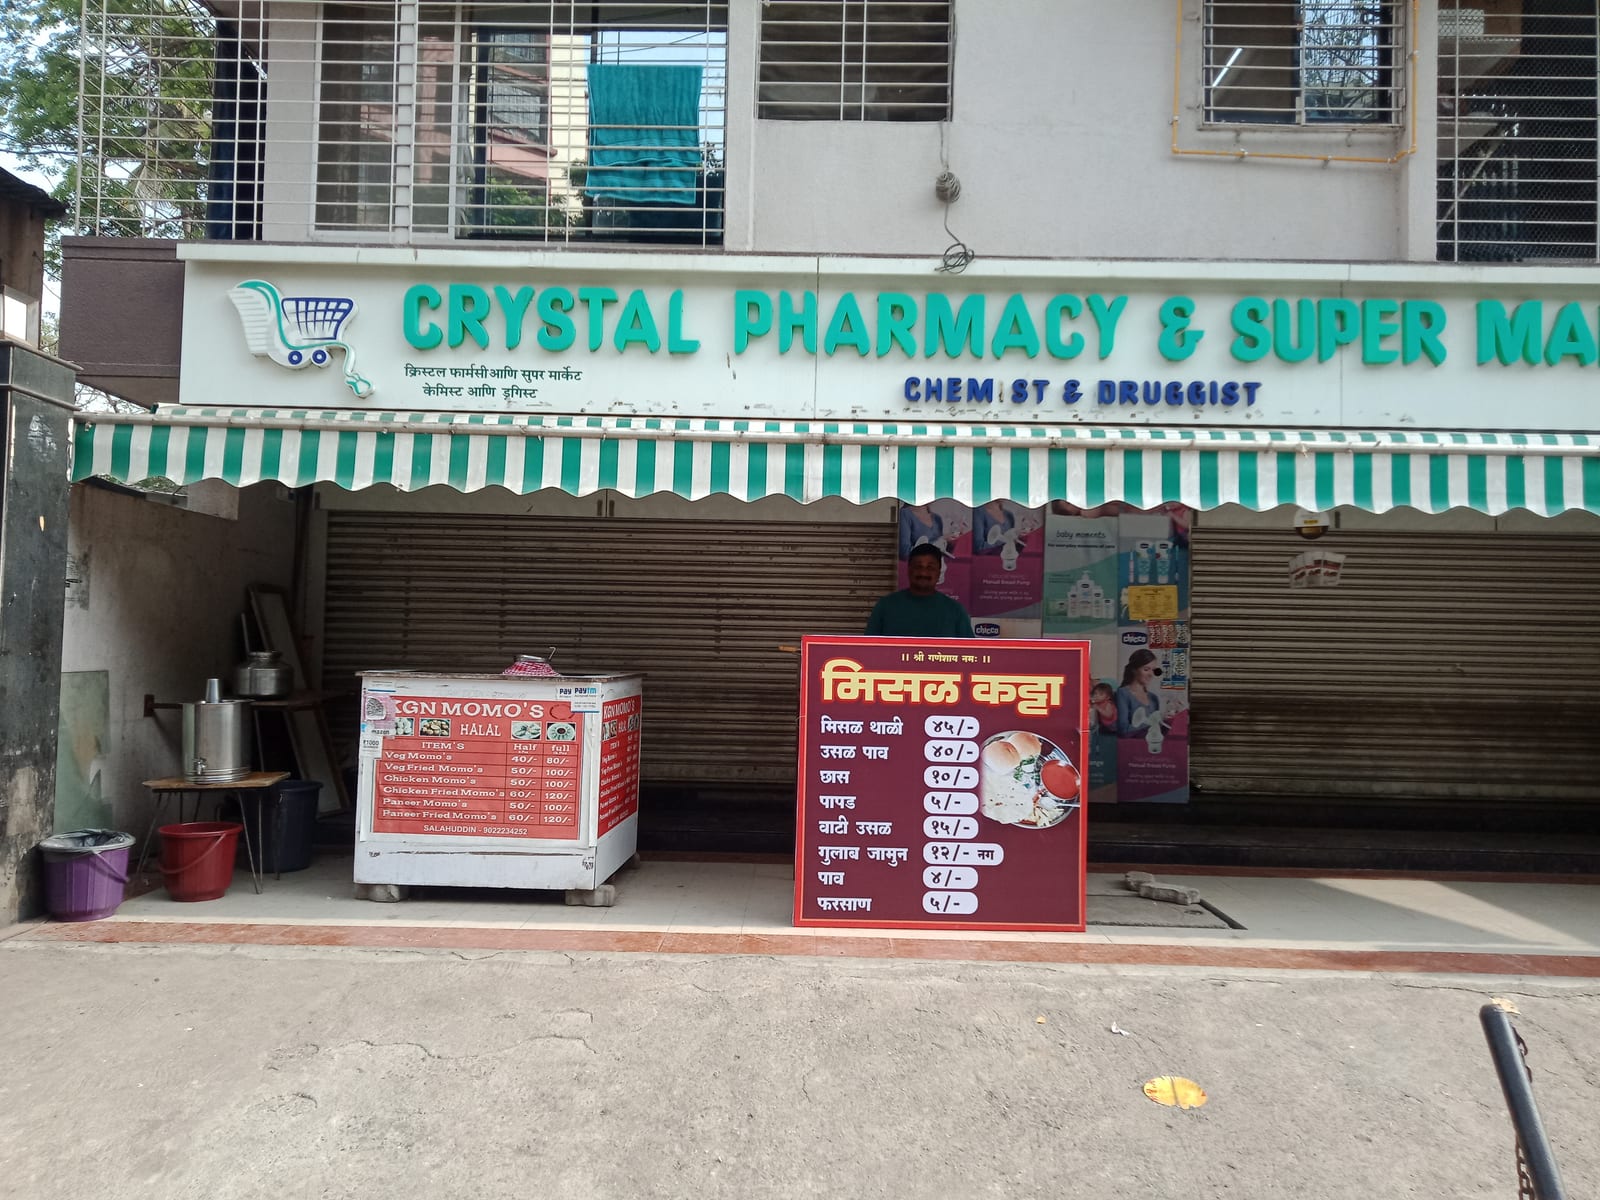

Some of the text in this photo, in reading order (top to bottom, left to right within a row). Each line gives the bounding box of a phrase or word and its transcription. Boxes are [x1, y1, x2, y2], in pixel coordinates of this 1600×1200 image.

[403, 284, 1600, 367] CRYSTAL PHARMACY & SUPER MA
[489, 366, 518, 379] आणि
[520, 368, 545, 383] सुपर
[548, 366, 582, 381] मार्केट
[422, 382, 464, 397] केमिस्ट
[467, 384, 496, 397] आणि
[904, 377, 1262, 406] CHEMST & DRUGGIST
[914, 651, 924, 662] श्री
[821, 659, 1064, 715] मिसळ कट्टा
[441, 702, 544, 718] MOMO'S
[460, 723, 501, 737] HALAL
[820, 715, 864, 734] मिसळ
[869, 715, 903, 735] थाळी
[422, 742, 465, 750] ITEM'S
[513, 743, 537, 751] Half
[820, 745, 857, 759] उसळ
[862, 746, 889, 760] पाव
[385, 751, 405, 760] Veg
[408, 752, 452, 760] Momo's
[385, 763, 405, 771] Veg
[438, 765, 483, 773] Momo's
[384, 775, 429, 783] Chicken
[431, 776, 476, 784] Momo's
[383, 786, 428, 794] Chicken
[431, 788, 458, 796] Fried
[460, 789, 505, 797] Momo's
[383, 798, 420, 806] Paneer
[423, 799, 468, 807] Momo's
[819, 795, 856, 809] पापड
[382, 809, 420, 817] Paneer
[422, 811, 451, 819] Fried
[452, 812, 497, 820] Momo's
[423, 825, 476, 833] SALAHUDDIN
[819, 815, 848, 834] वाटी
[856, 821, 892, 835] उसळ
[818, 846, 860, 865] गुलाब
[867, 847, 908, 867] जामुन
[977, 850, 994, 861] नग
[817, 871, 845, 885] पाव
[817, 897, 872, 911] फरसाण
